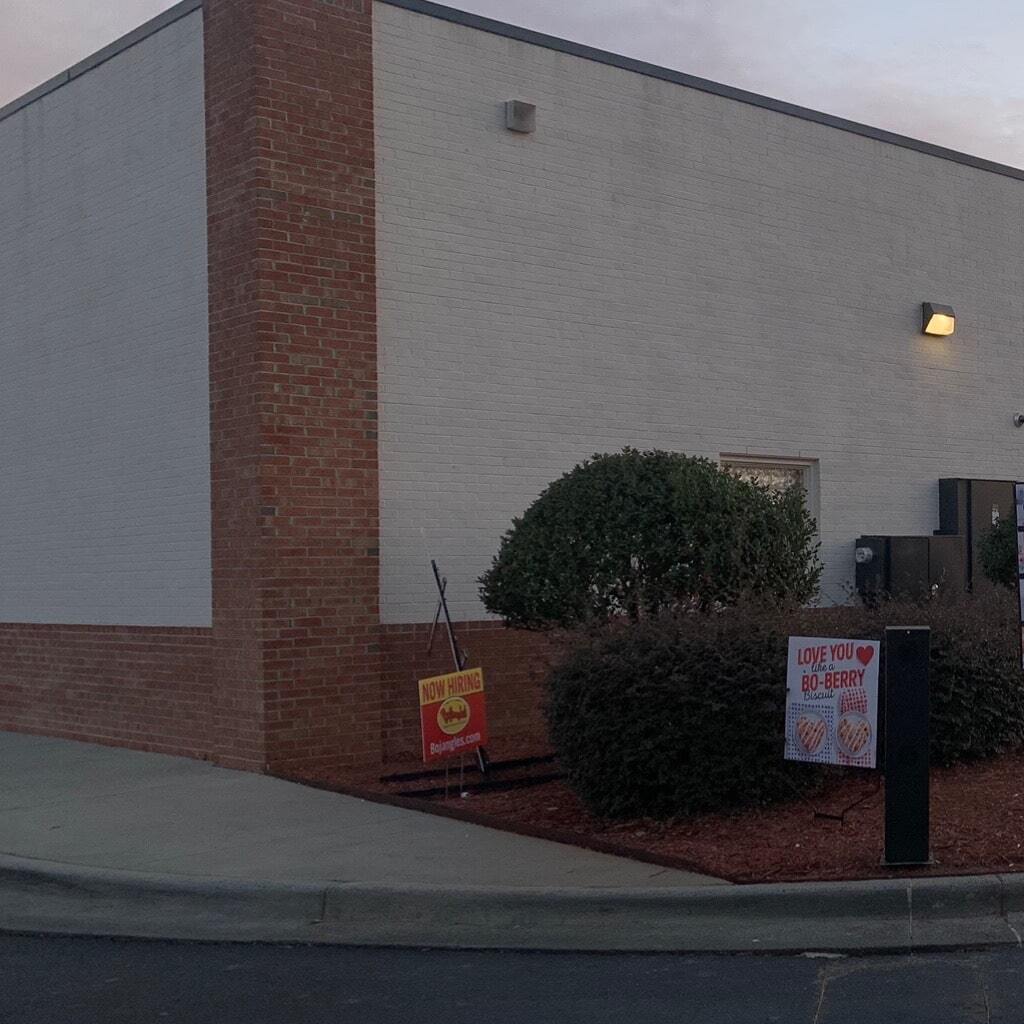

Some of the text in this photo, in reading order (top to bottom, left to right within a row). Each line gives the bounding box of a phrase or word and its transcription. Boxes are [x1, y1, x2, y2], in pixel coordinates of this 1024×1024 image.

[797, 642, 855, 665] LOVE YOU
[811, 662, 827, 673] like
[422, 671, 481, 703] NOW HIRING
[801, 668, 866, 692] BO-BERRY
[804, 689, 834, 701] Biscuit
